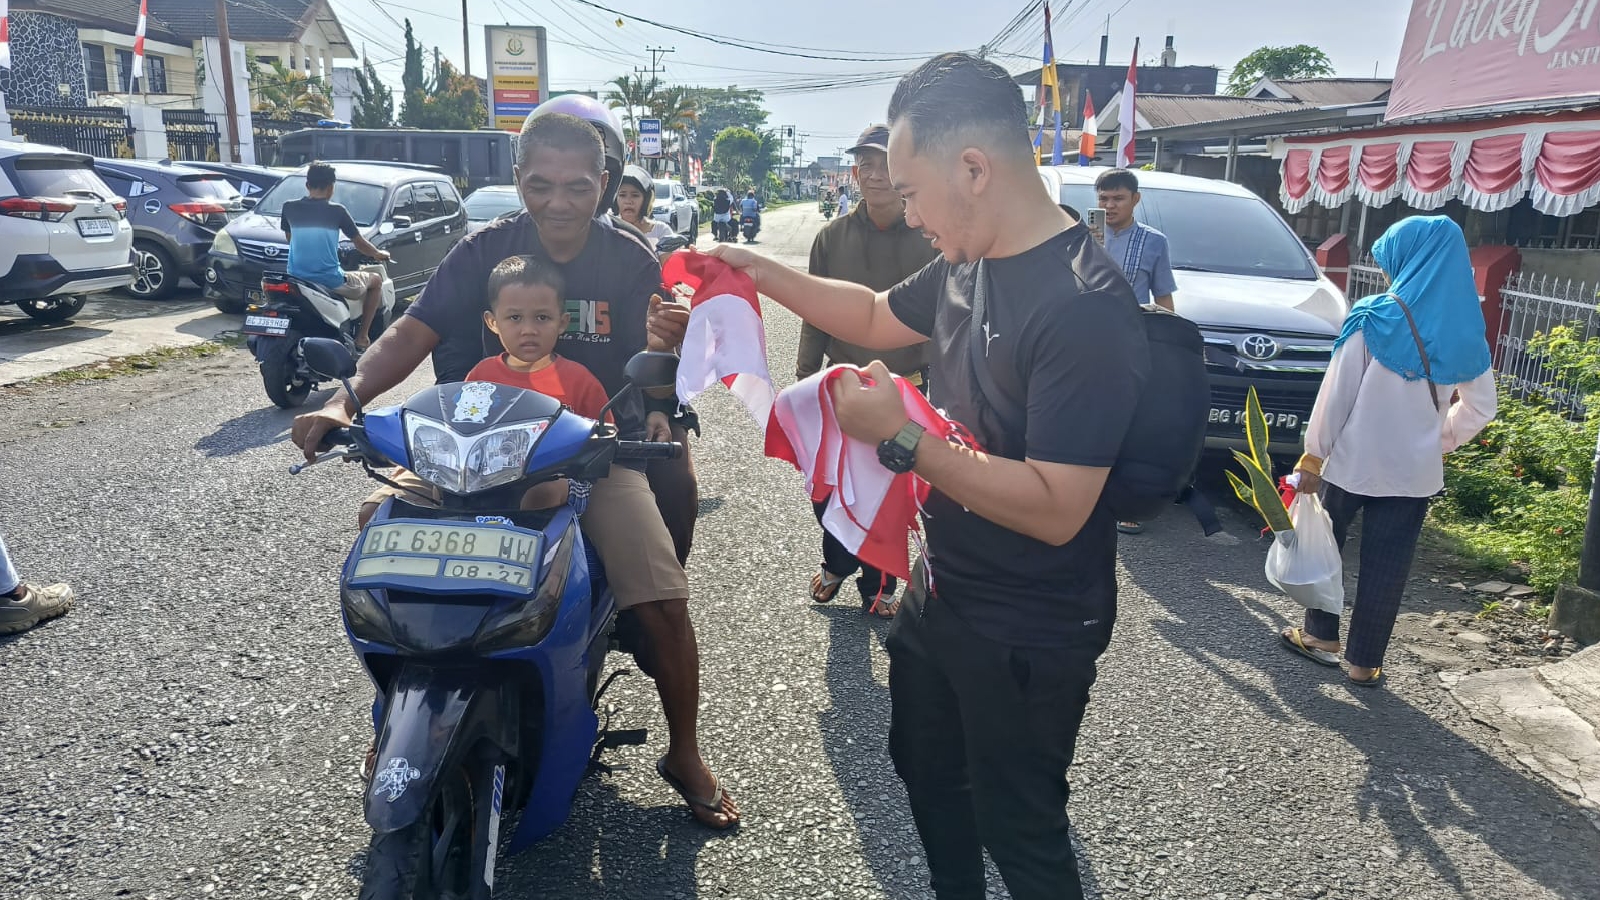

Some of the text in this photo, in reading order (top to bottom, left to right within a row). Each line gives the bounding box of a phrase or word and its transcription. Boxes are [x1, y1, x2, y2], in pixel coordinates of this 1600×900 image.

[1208, 408, 1231, 424] BG
[1276, 413, 1299, 429] PD
[368, 530, 402, 553] BG
[411, 529, 476, 555] 6368
